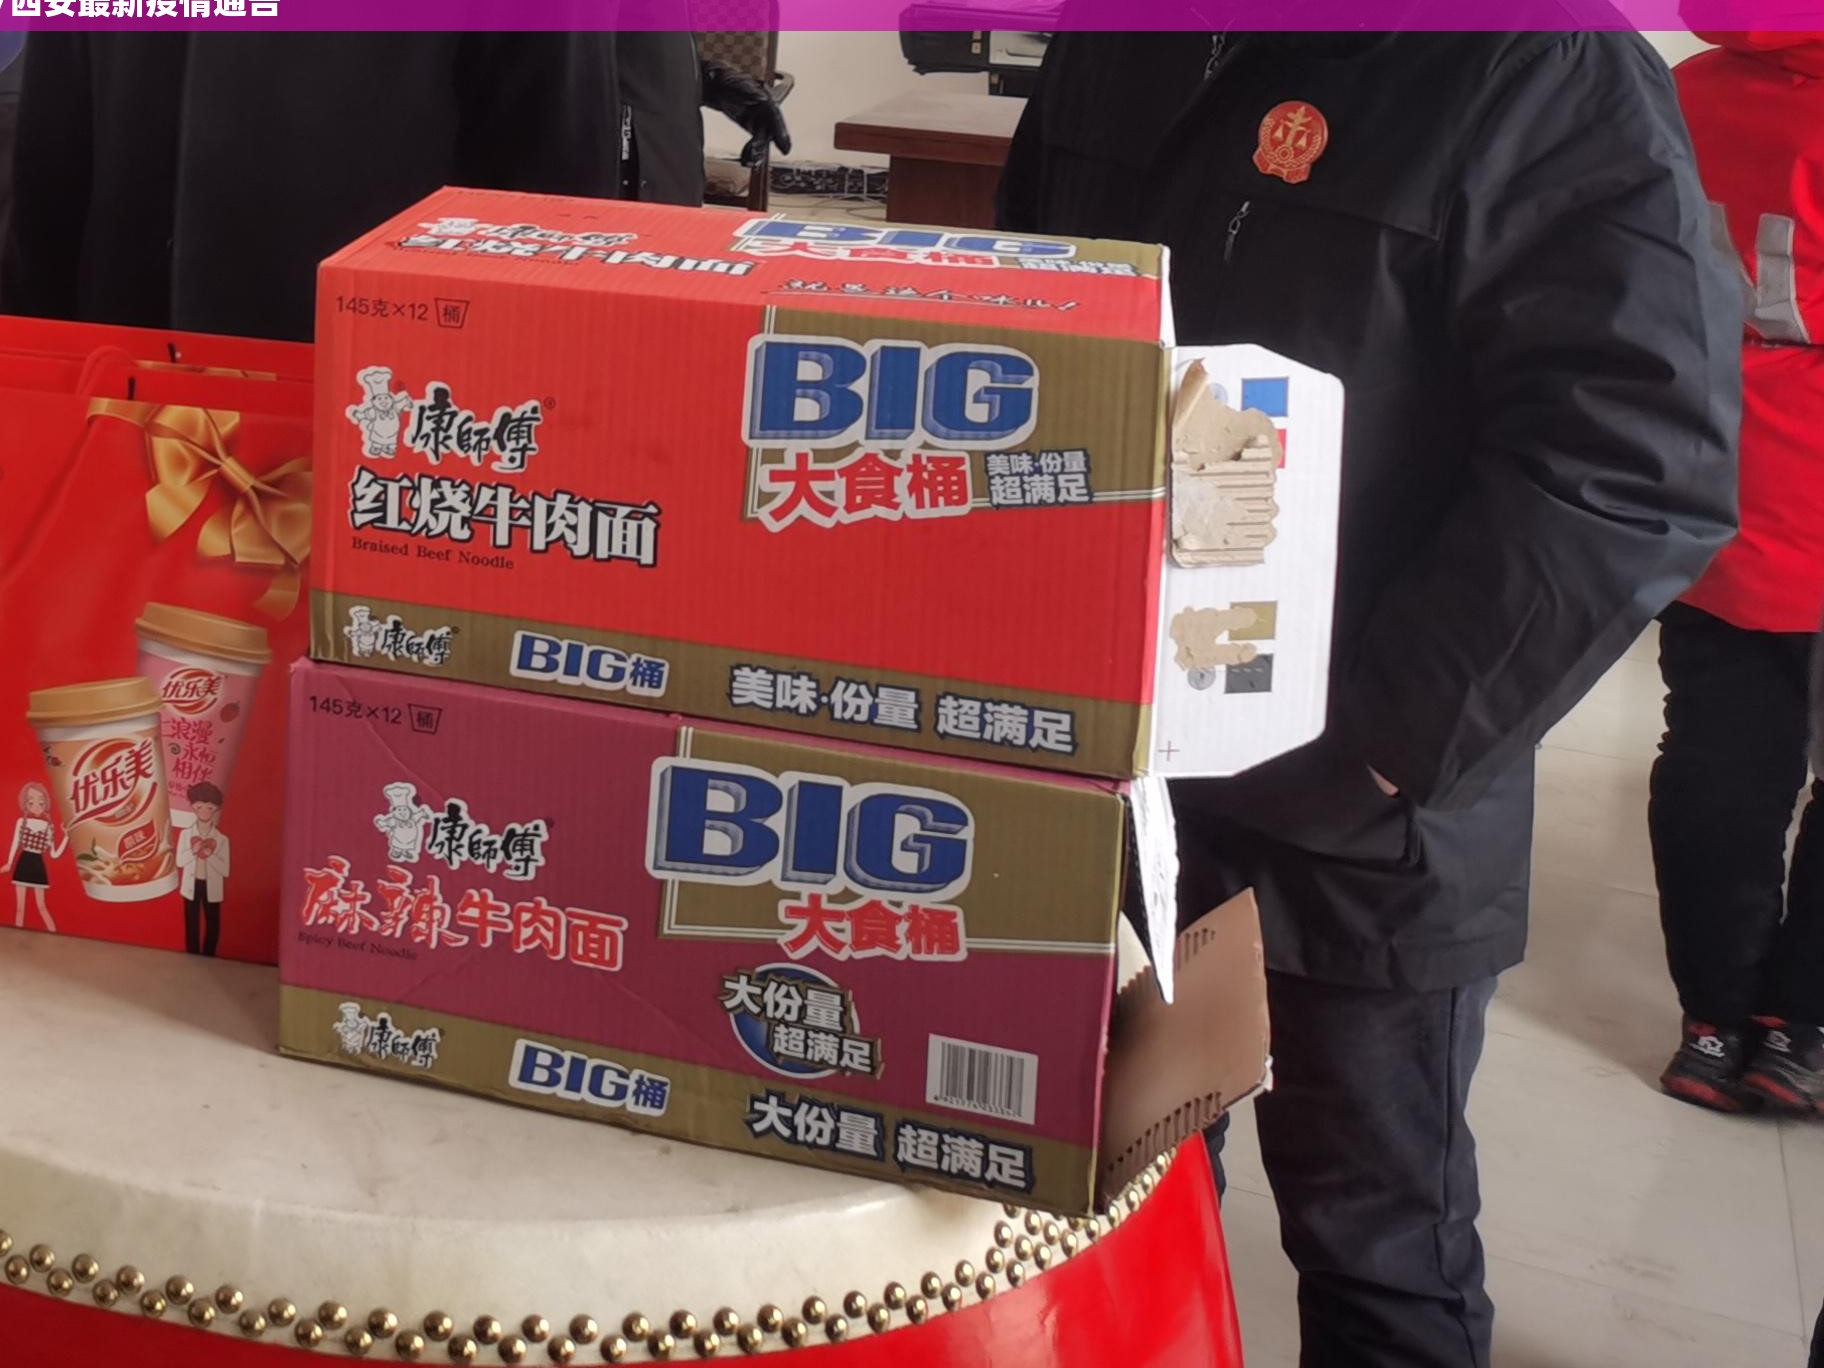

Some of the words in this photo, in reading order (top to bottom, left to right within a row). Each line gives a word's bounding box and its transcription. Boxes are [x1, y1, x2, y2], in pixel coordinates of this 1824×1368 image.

[739, 220, 1073, 255] BIG
[336, 296, 428, 321] 145克×12
[747, 340, 1036, 440] BIG
[409, 385, 542, 471] 康師傅
[767, 450, 969, 521] 大食桶
[989, 473, 1090, 507] 超满足
[349, 467, 661, 567] 红烧牛肉面
[351, 537, 409, 557] Braised
[416, 545, 452, 562] Beef
[458, 551, 514, 569] Noodle
[162, 674, 221, 700] 优乐美
[309, 696, 402, 724] 145克×12
[937, 695, 1076, 753] 超满足
[70, 738, 154, 813] 优乐美
[427, 802, 542, 877] 康師傅
[653, 765, 969, 894] BIG
[302, 856, 628, 971] 麻辣牛肉面
[782, 893, 962, 955] 大食桶
[723, 974, 845, 1032] 大份量
[773, 1024, 873, 1073] 超满足
[752, 1095, 879, 1157] 大份量
[897, 1125, 1027, 1189] 超满足
